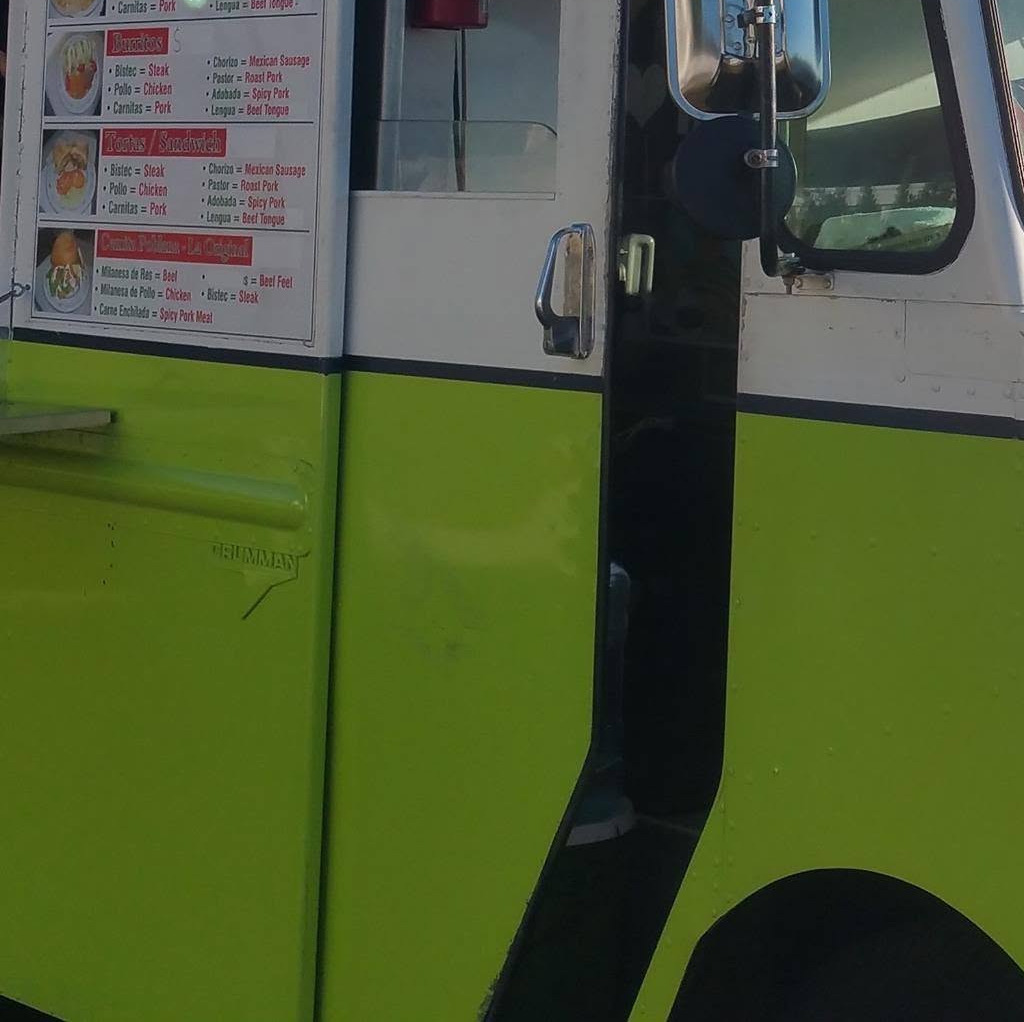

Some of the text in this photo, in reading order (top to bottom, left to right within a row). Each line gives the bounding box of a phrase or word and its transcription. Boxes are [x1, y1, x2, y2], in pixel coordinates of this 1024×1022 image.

[118, 0, 147, 13] Carnitas
[249, 55, 278, 67] Mexican
[280, 54, 310, 68] Sausage
[148, 62, 170, 76] Steak
[245, 71, 265, 83] Roast
[267, 71, 282, 83] Pork
[143, 82, 172, 96] Chicken
[252, 87, 271, 101] Spicy
[273, 87, 290, 99] Pork
[113, 101, 143, 114] Carnitas
[154, 100, 172, 114] Pork
[246, 104, 262, 116] Beef
[264, 104, 289, 117] Tongue
[143, 163, 165, 178] Steak
[244, 163, 274, 175] Mexican
[275, 163, 306, 178] Sausage
[138, 182, 168, 197] Chicken
[240, 179, 260, 191] Roast
[262, 180, 279, 192] Pork
[108, 200, 138, 215] Carnitas
[149, 202, 167, 216] Pork
[247, 196, 267, 210] Spicy
[269, 196, 286, 209] Pork
[242, 212, 258, 224] Beef
[260, 212, 285, 227] Tongue
[162, 269, 178, 283] Beef
[259, 274, 275, 287] Beef
[165, 287, 191, 302] Chicken
[239, 290, 259, 304] Steak
[100, 303, 117, 316] Carne
[160, 308, 177, 323] Spicy
[179, 309, 194, 323] Pork
[196, 310, 213, 324] Meat
